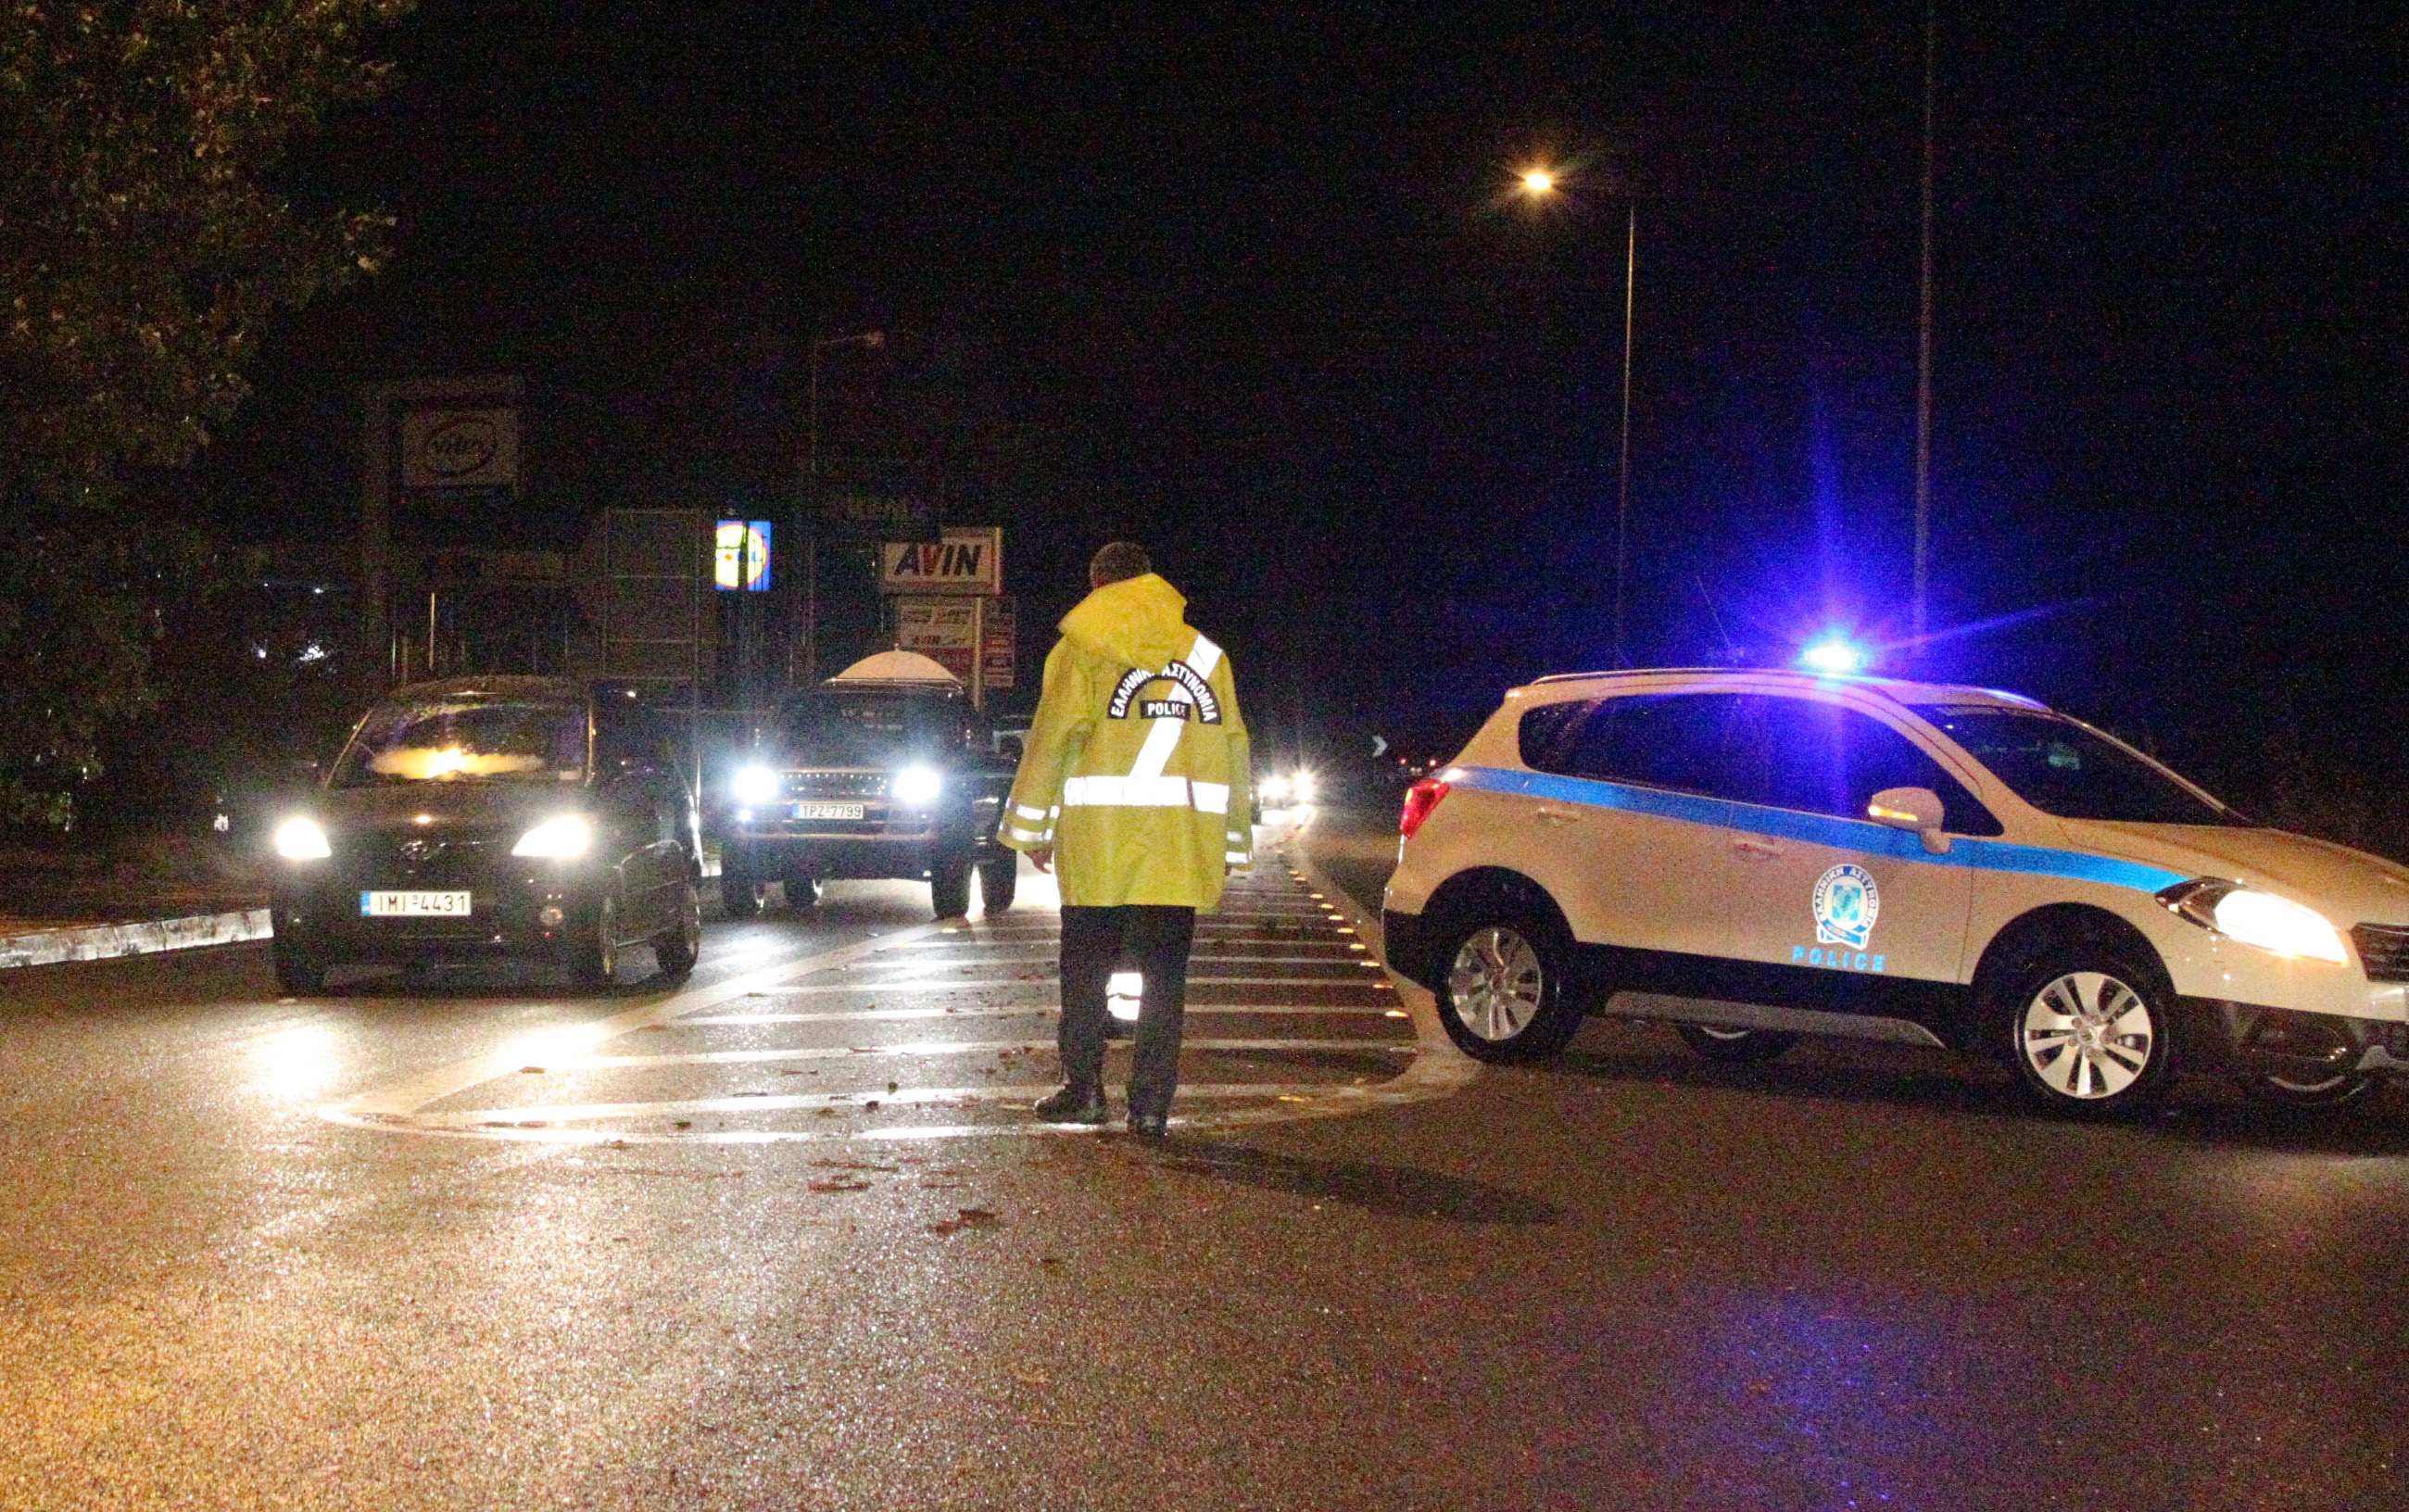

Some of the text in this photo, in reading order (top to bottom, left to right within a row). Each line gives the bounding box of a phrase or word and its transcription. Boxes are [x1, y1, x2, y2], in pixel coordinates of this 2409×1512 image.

[895, 544, 981, 576] AVIN
[1111, 662, 1217, 722] ΕΛΛΗΝΙΚ ΑΣΤΥΝΟΜΙΑ
[1147, 702, 1186, 717] POLICE
[1792, 946, 1887, 973] POLICE
